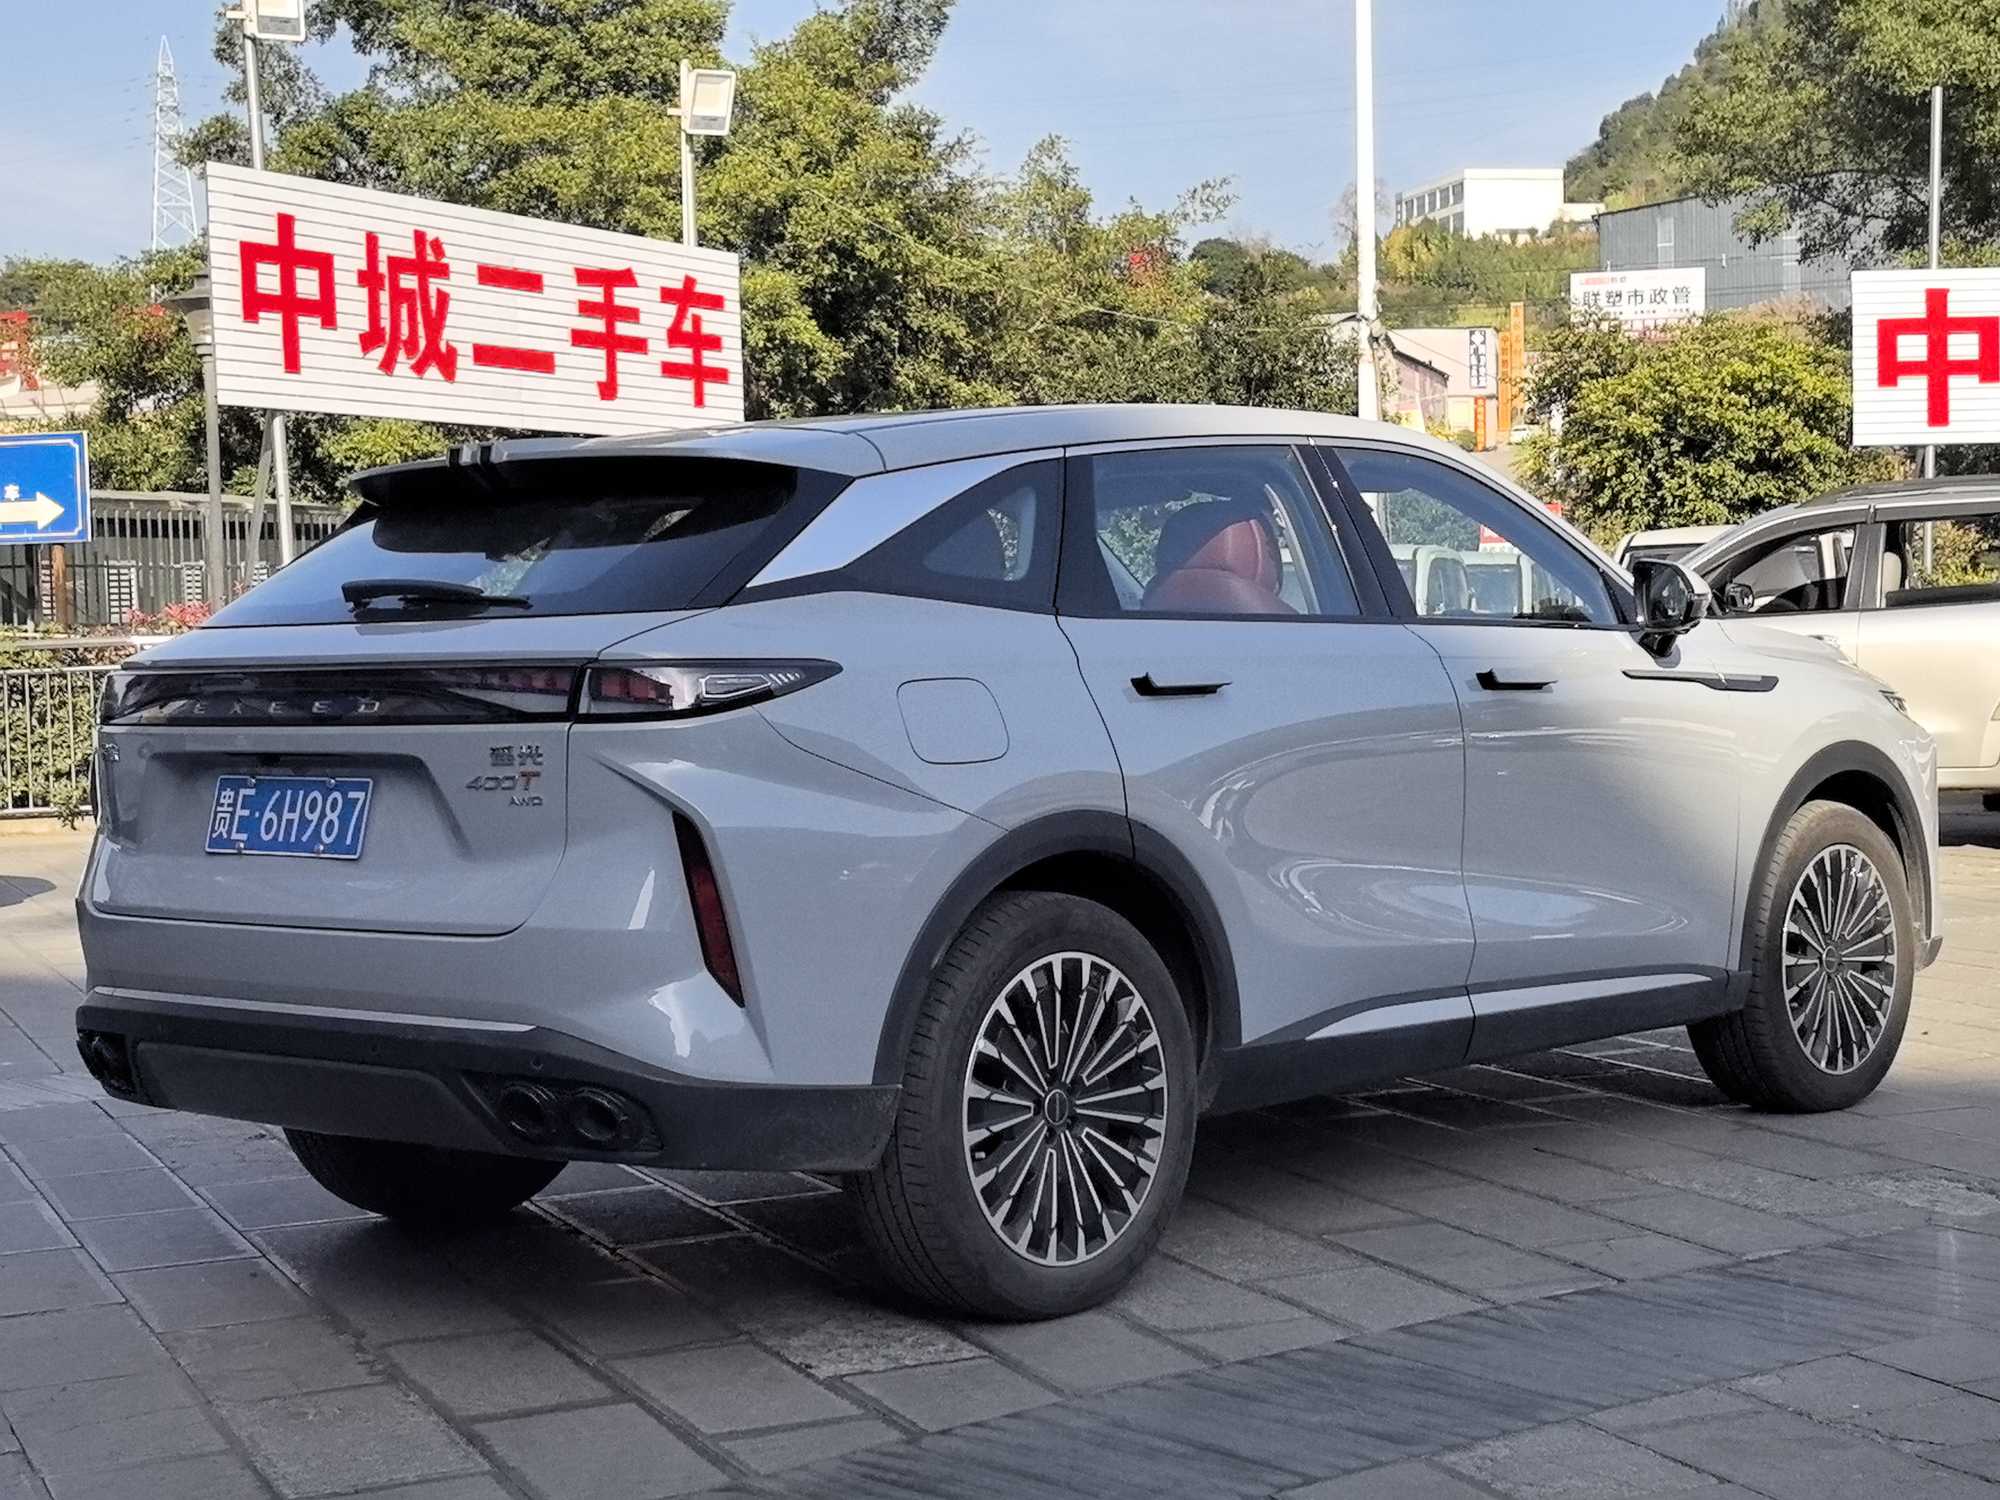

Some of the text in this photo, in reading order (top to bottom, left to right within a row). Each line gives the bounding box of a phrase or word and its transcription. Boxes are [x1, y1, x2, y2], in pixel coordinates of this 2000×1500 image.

[239, 212, 730, 409] 中城二手车
[1877, 288, 2000, 427] 中
[193, 699, 381, 715] EXEED
[465, 770, 541, 791] 400T
[508, 795, 543, 807] AWD
